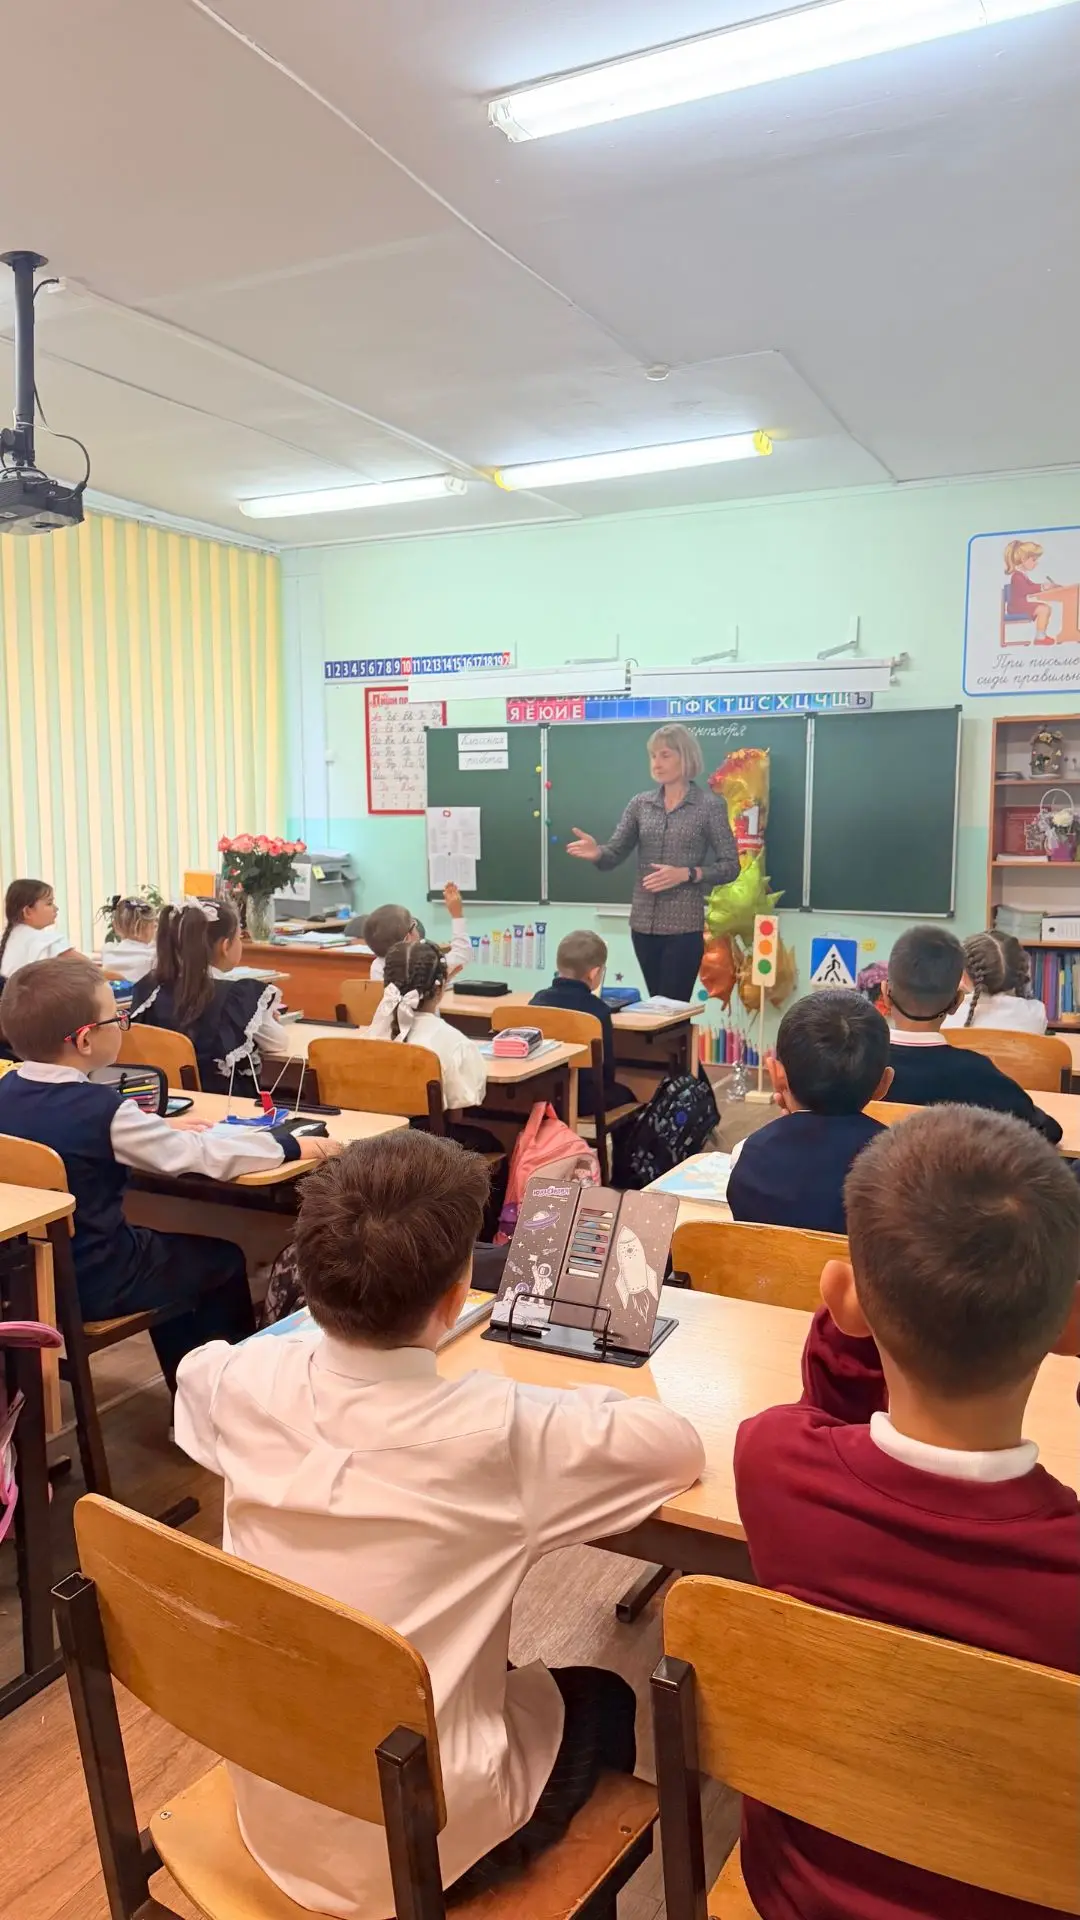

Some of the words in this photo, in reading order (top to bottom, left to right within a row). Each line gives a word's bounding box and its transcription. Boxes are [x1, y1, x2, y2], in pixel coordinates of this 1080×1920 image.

[992, 653, 1025, 674] При
[977, 674, 1008, 690] сиди
[743, 806, 759, 835] 1
